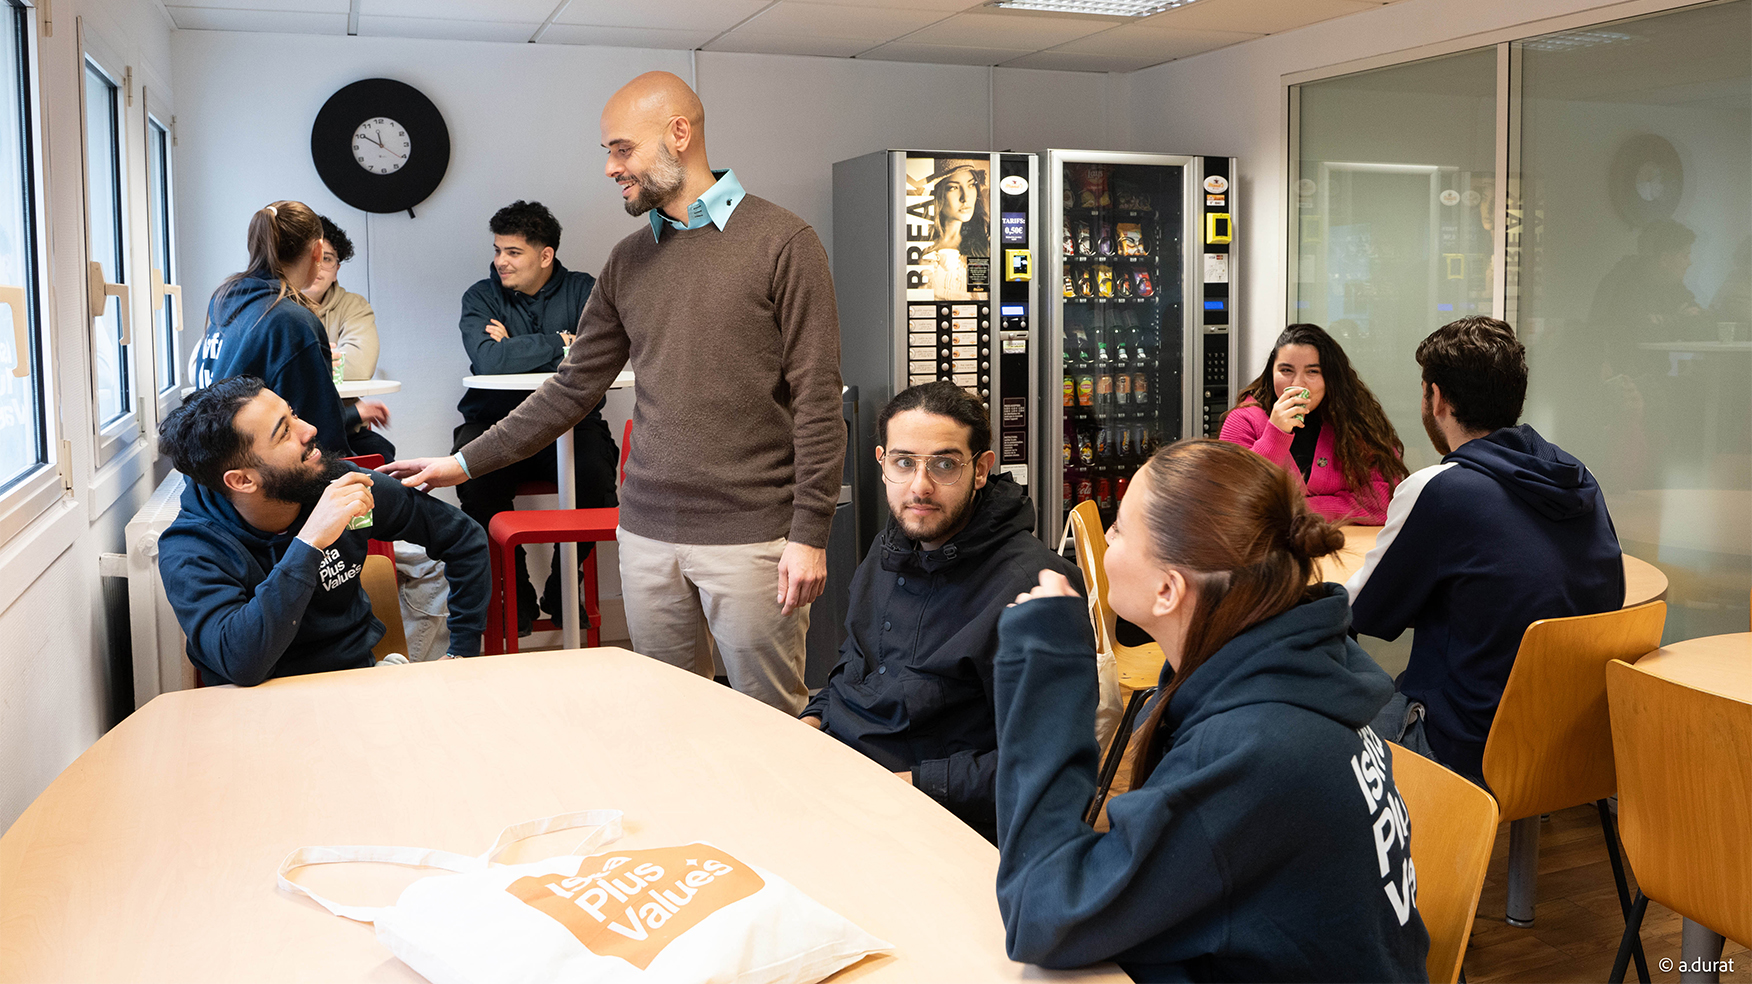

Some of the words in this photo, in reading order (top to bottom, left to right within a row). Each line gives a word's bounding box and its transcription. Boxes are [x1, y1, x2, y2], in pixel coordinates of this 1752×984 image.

[906, 172, 935, 289] BREAK
[319, 560, 346, 582] Plus
[322, 564, 362, 592] Values
[573, 862, 665, 923] Plus
[606, 859, 734, 941] Values
